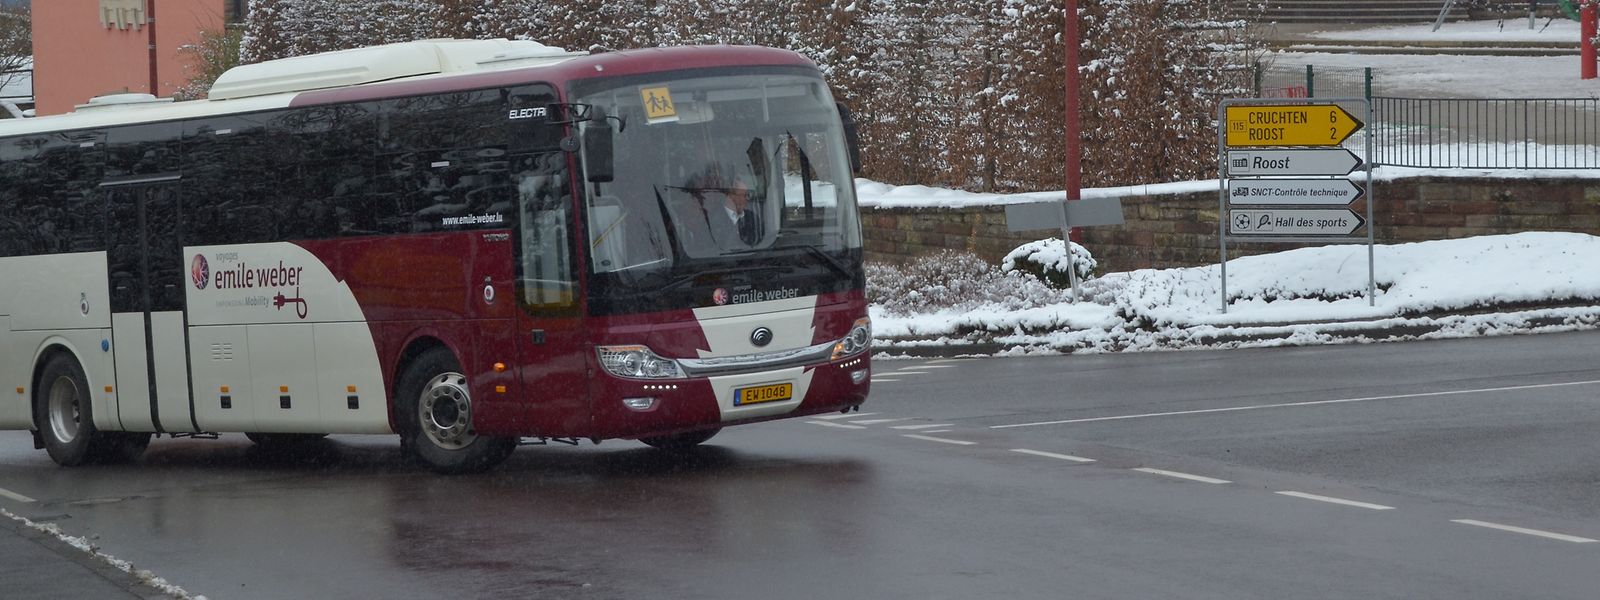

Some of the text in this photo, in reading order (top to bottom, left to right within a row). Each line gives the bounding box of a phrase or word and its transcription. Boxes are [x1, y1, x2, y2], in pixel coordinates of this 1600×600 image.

[1248, 110, 1337, 124] CRUCHTEN 6
[1233, 122, 1244, 131] 115
[1249, 127, 1337, 141] ROOST 2
[1252, 156, 1290, 169] Roost
[1251, 187, 1348, 198] SNCT-Contrôle technique
[442, 212, 503, 225] www.emile-weber.lu
[1275, 217, 1348, 231] Hall des sports
[214, 260, 303, 290] emile weber
[732, 289, 763, 304] emile
[765, 286, 799, 300] weber
[746, 386, 786, 401] EW1048
